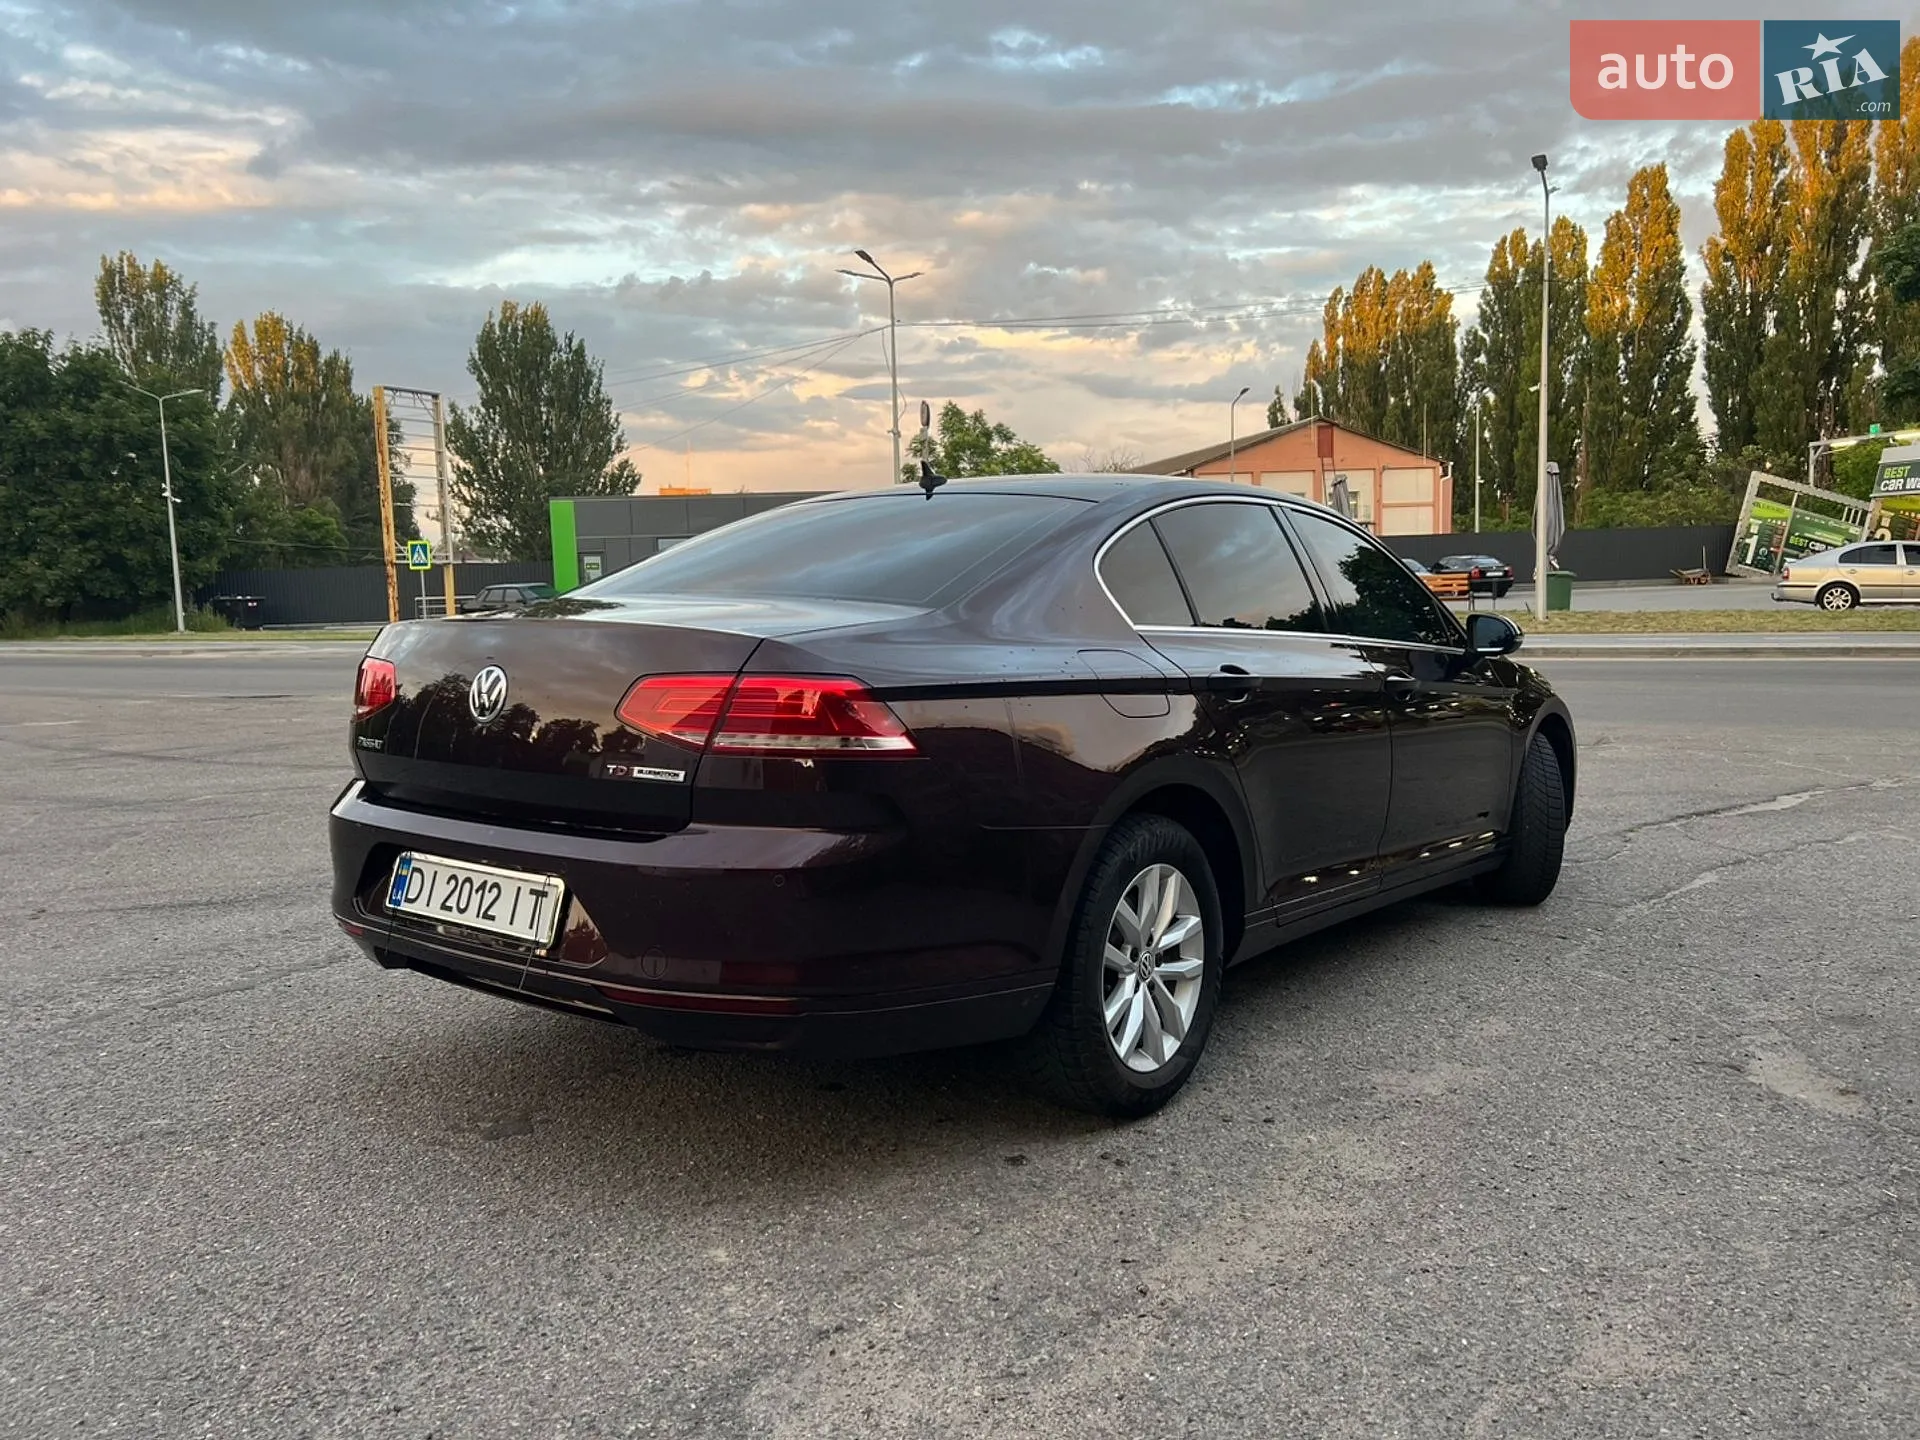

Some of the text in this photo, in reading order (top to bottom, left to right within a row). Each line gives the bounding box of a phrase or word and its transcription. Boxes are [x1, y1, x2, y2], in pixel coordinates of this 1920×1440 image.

[1883, 465, 1911, 479] BEST
[403, 866, 549, 930] DI 2012 IT
